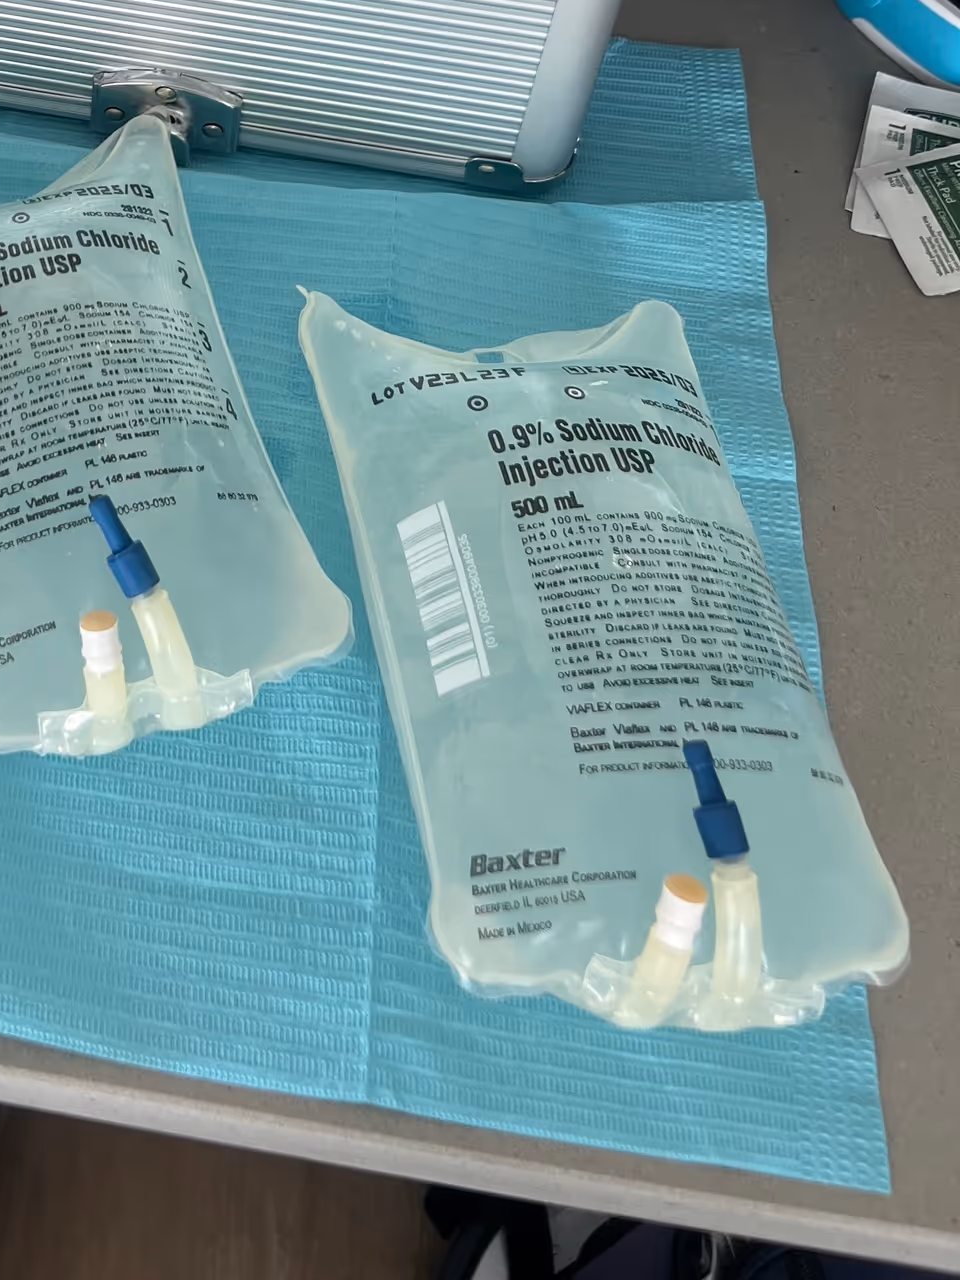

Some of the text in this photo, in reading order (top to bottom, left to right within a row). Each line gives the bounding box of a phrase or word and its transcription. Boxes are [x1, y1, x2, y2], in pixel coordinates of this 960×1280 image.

[74, 183, 154, 200] 2025/03
[927, 165, 957, 205] Thick Pad
[75, 229, 161, 256] Chloride
[39, 253, 82, 277] USP
[178, 266, 192, 289] 2
[17, 308, 58, 323] CONTAINS
[198, 329, 212, 352] 3
[586, 365, 699, 398] EXP 2025/03
[371, 381, 405, 406] LOT
[226, 397, 238, 420] 4
[487, 417, 721, 467] 0.9% Sodium Chloride
[498, 447, 656, 487] Injection USP
[89, 479, 104, 491] PL
[511, 491, 584, 519] 500 mL
[597, 510, 664, 521] CONTAINS 900
[16, 527, 51, 546] PRODUCT
[527, 549, 604, 567] NONPYROGENIC
[569, 572, 632, 585] INTRODUCING
[538, 587, 601, 603] THOROUGHLY
[541, 597, 676, 616] DIRECTED PHYSICIAN
[605, 623, 650, 633] DISCARD
[558, 666, 612, 680] OVERWRAP
[566, 701, 613, 715] VIAFLEX
[570, 726, 607, 739] Baxter
[600, 761, 640, 773] PRODUCT
[470, 847, 566, 878] Baxter
[471, 870, 637, 897] BAXTER HEALTHCARE CORPORATION
[474, 889, 586, 915] DEERFIELD IL 60015 USA
[477, 926, 505, 940] MADE
[517, 919, 553, 935] MEXICO
